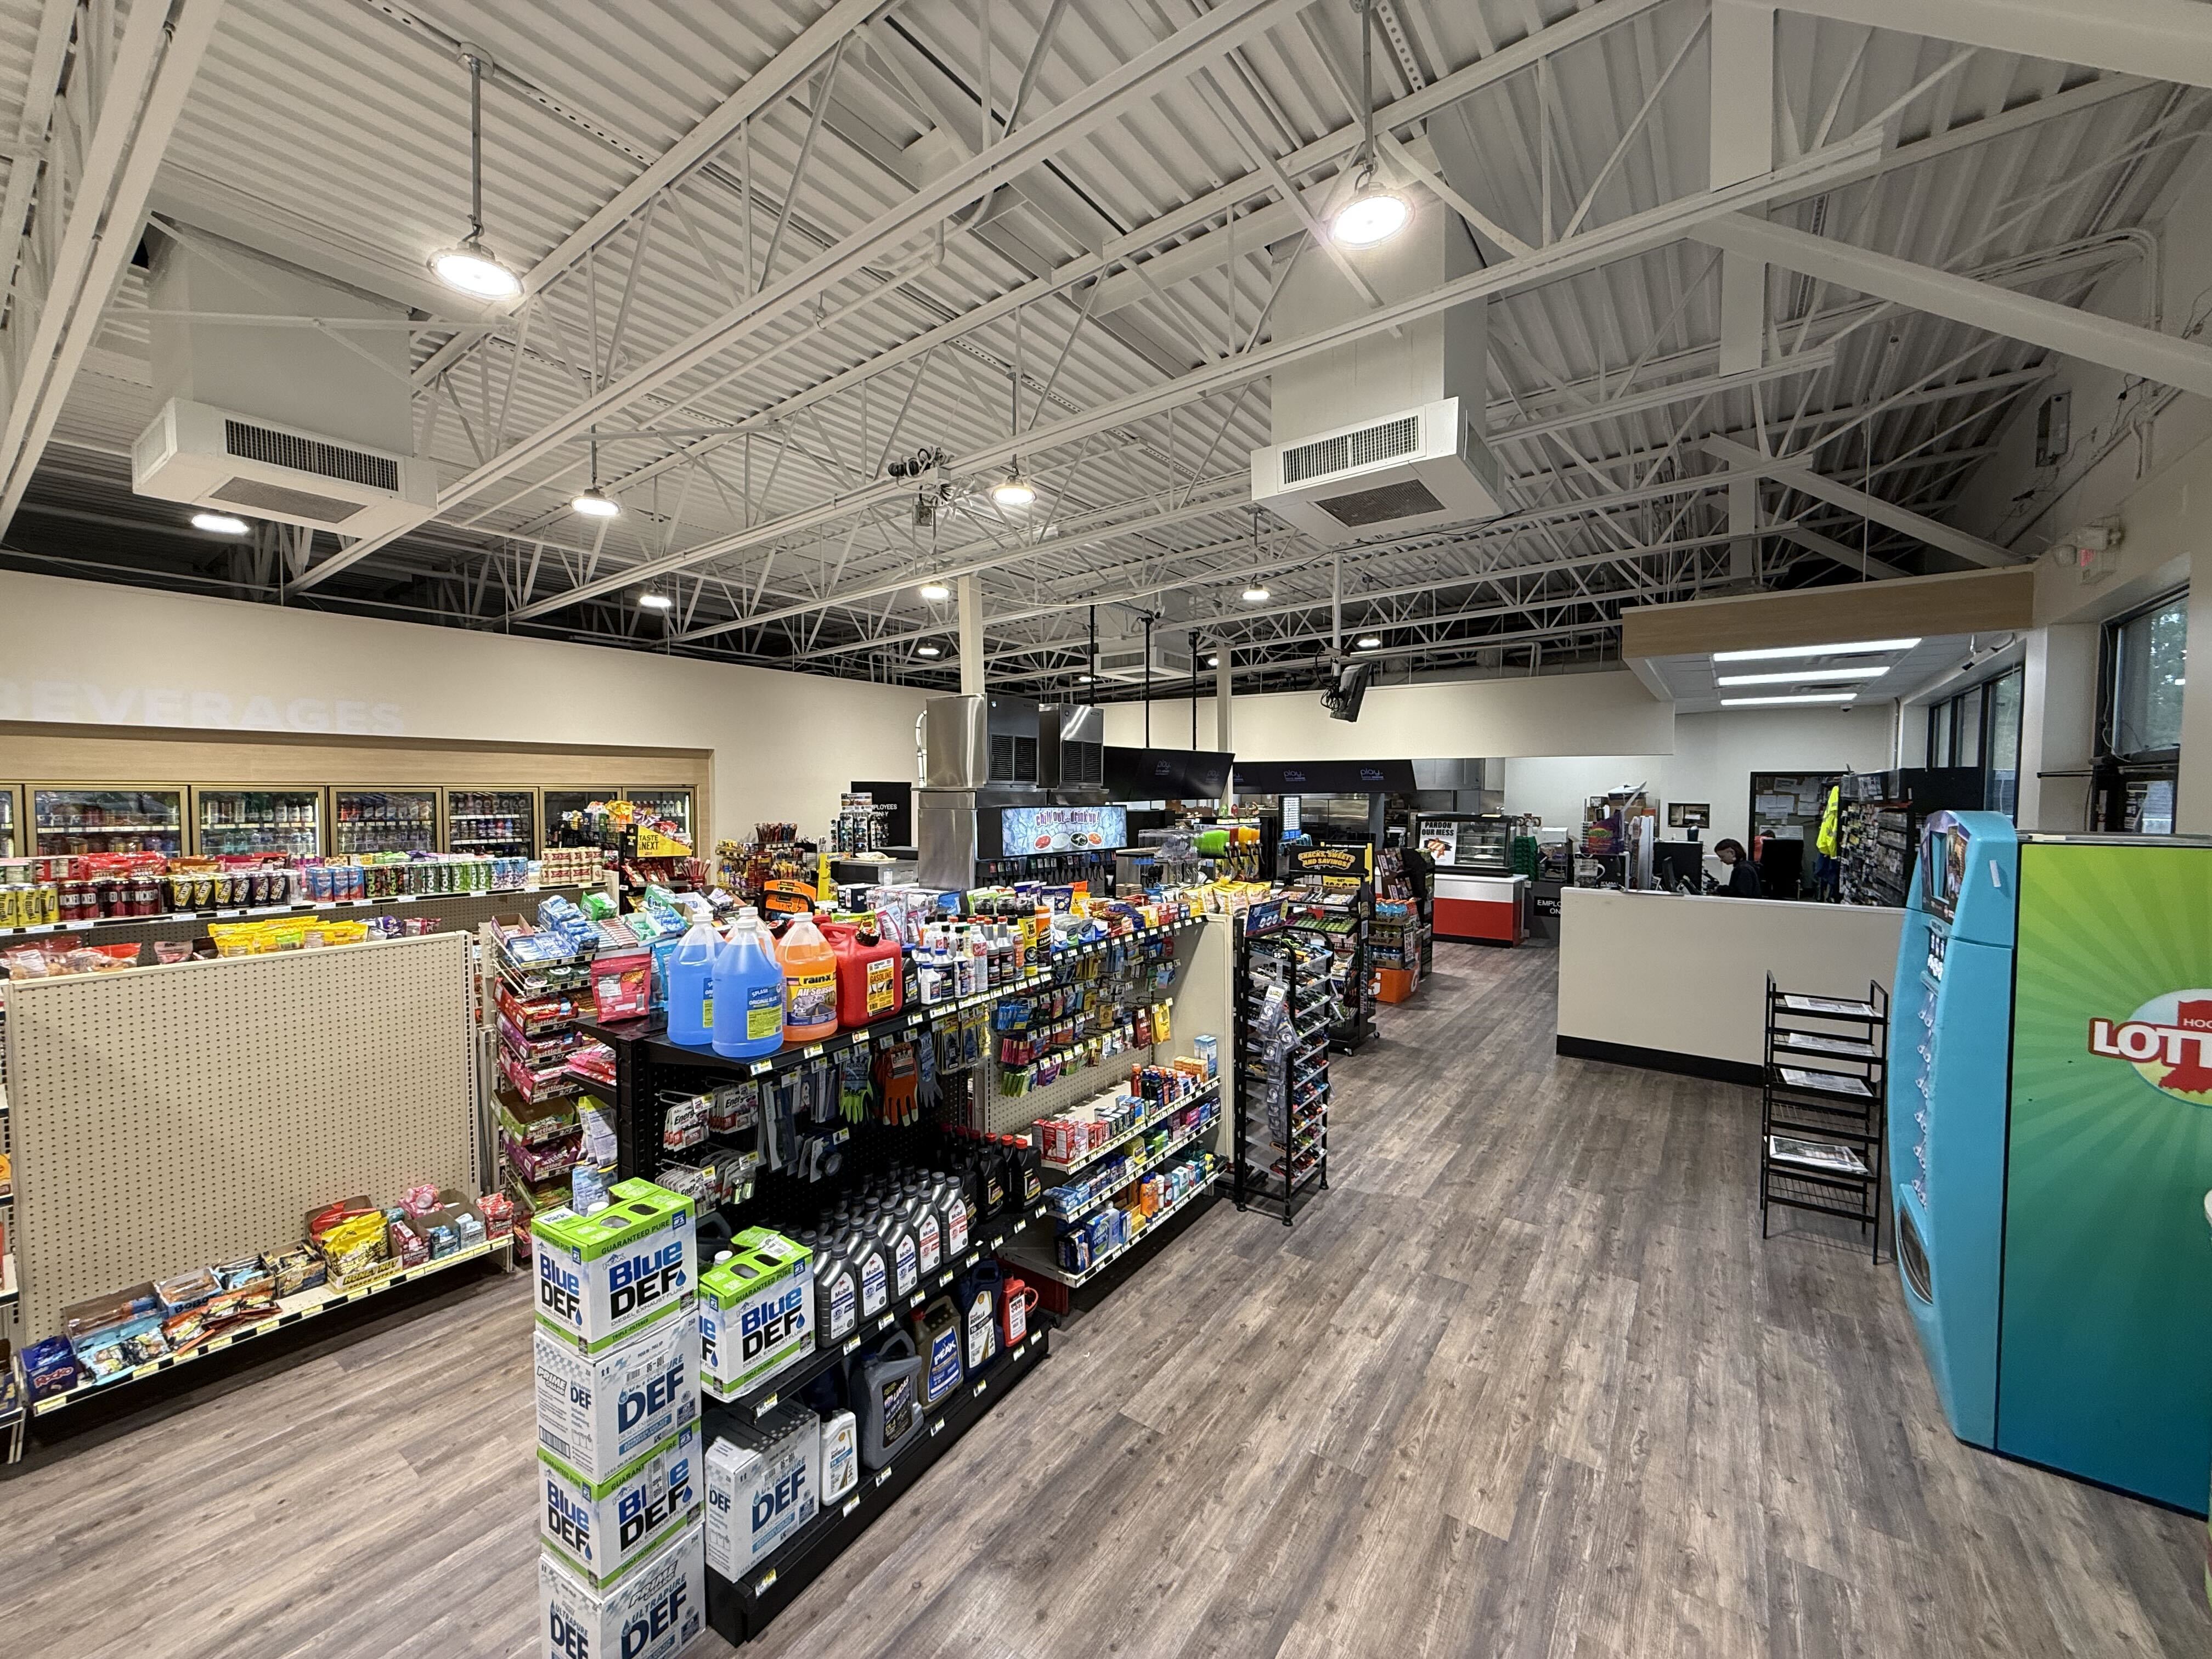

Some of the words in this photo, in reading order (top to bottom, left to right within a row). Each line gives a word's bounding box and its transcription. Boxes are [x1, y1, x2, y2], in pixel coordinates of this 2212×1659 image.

[1036, 812, 1051, 826] chill
[642, 842, 658, 850] NEXT
[1299, 851, 1327, 860] SNACKS,
[1328, 851, 1355, 862] SWEETS
[1318, 858, 1348, 867] SAVINGS!
[136, 889, 158, 901] WICKED
[1537, 899, 1562, 907] EMPLO
[870, 970, 892, 984] GASOLINE
[752, 988, 768, 997] SPLASH
[532, 1047, 562, 1058] Skittles
[2094, 1021, 2212, 1069] LOTT
[535, 1084, 565, 1094] Skittles
[674, 1109, 695, 1125] Energ
[527, 1125, 558, 1139] Skittles
[674, 1216, 685, 1226] #1
[952, 1210, 963, 1220] Mobil
[601, 1229, 650, 1255] GUARANTEED
[651, 1219, 670, 1233] PURE
[923, 1226, 936, 1238] Mobil
[558, 1241, 571, 1253] PURE
[573, 1251, 580, 1261] #1
[900, 1246, 912, 1259] Mobil
[342, 1267, 379, 1285] HONEY
[378, 1258, 399, 1273] NUT
[540, 1252, 580, 1296] Blue
[610, 1241, 682, 1293] Blue
[794, 1263, 805, 1273] #1
[866, 1265, 881, 1277] Mobil
[611, 1260, 684, 1321] DEF
[736, 1276, 776, 1304] GUARANTEED
[776, 1267, 792, 1283] PURE
[835, 1285, 850, 1299] Mobil
[541, 1277, 580, 1321] DEF
[611, 1313, 635, 1327] DIESEL
[636, 1296, 665, 1314] EXHAUST
[665, 1285, 685, 1298] FLUID
[710, 1299, 718, 1309] #1
[742, 1287, 803, 1337] Blue
[743, 1305, 803, 1363] DEF
[763, 1338, 788, 1356] EXHAUST
[788, 1328, 804, 1340] FLUID
[934, 1339, 957, 1365] PEAK
[537, 1365, 567, 1389] PRIME
[893, 1375, 910, 1402] LUCAS
[571, 1385, 592, 1411] DEF
[618, 1363, 684, 1434] DEF
[680, 1434, 691, 1444] #1
[611, 1462, 646, 1490] GUARANT
[548, 1479, 589, 1532] Blue
[709, 1489, 731, 1514] DEF
[752, 1464, 806, 1534] DEF
[620, 1476, 690, 1553] DEF
[548, 1503, 590, 1553] DEF
[620, 1539, 645, 1559] DIESEL
[632, 1572, 687, 1623] ULTRAPURE
[556, 1604, 589, 1638] ULTRAPURE
[621, 1580, 687, 1659] DEF
[550, 1613, 589, 1659] DEF
